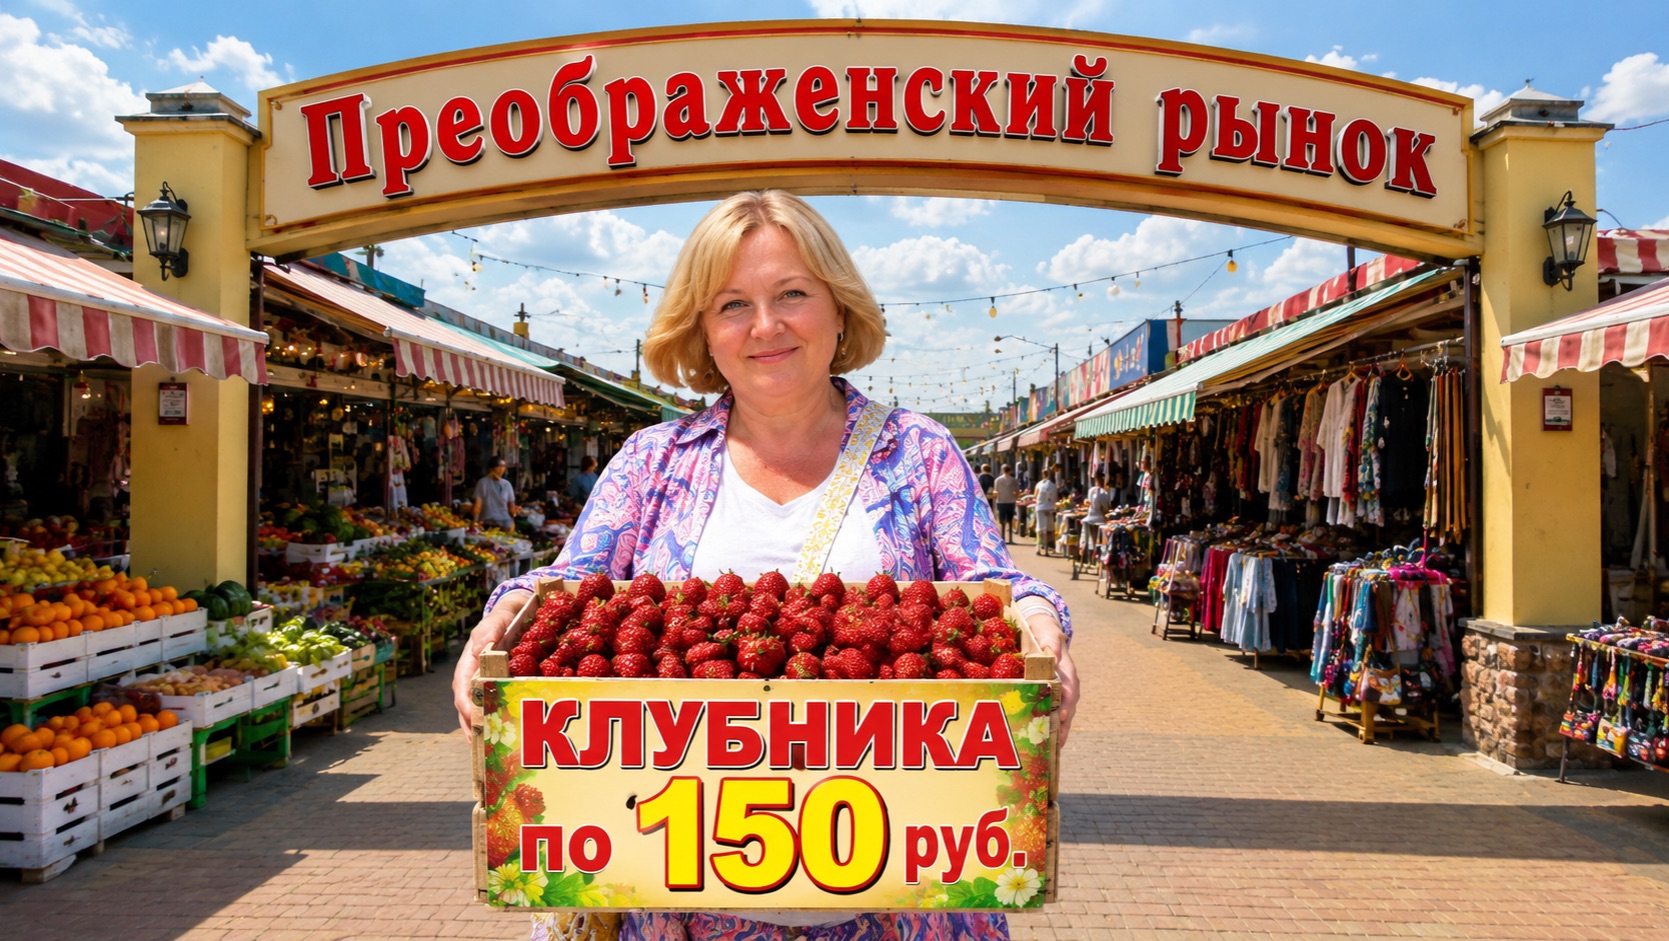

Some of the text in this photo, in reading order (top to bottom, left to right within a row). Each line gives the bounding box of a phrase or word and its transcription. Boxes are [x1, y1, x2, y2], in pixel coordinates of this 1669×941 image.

[300, 53, 1438, 199] Преображенский рынок
[520, 699, 1022, 771] КЛУБНИКА
[520, 775, 1028, 894] по 150 руб.
